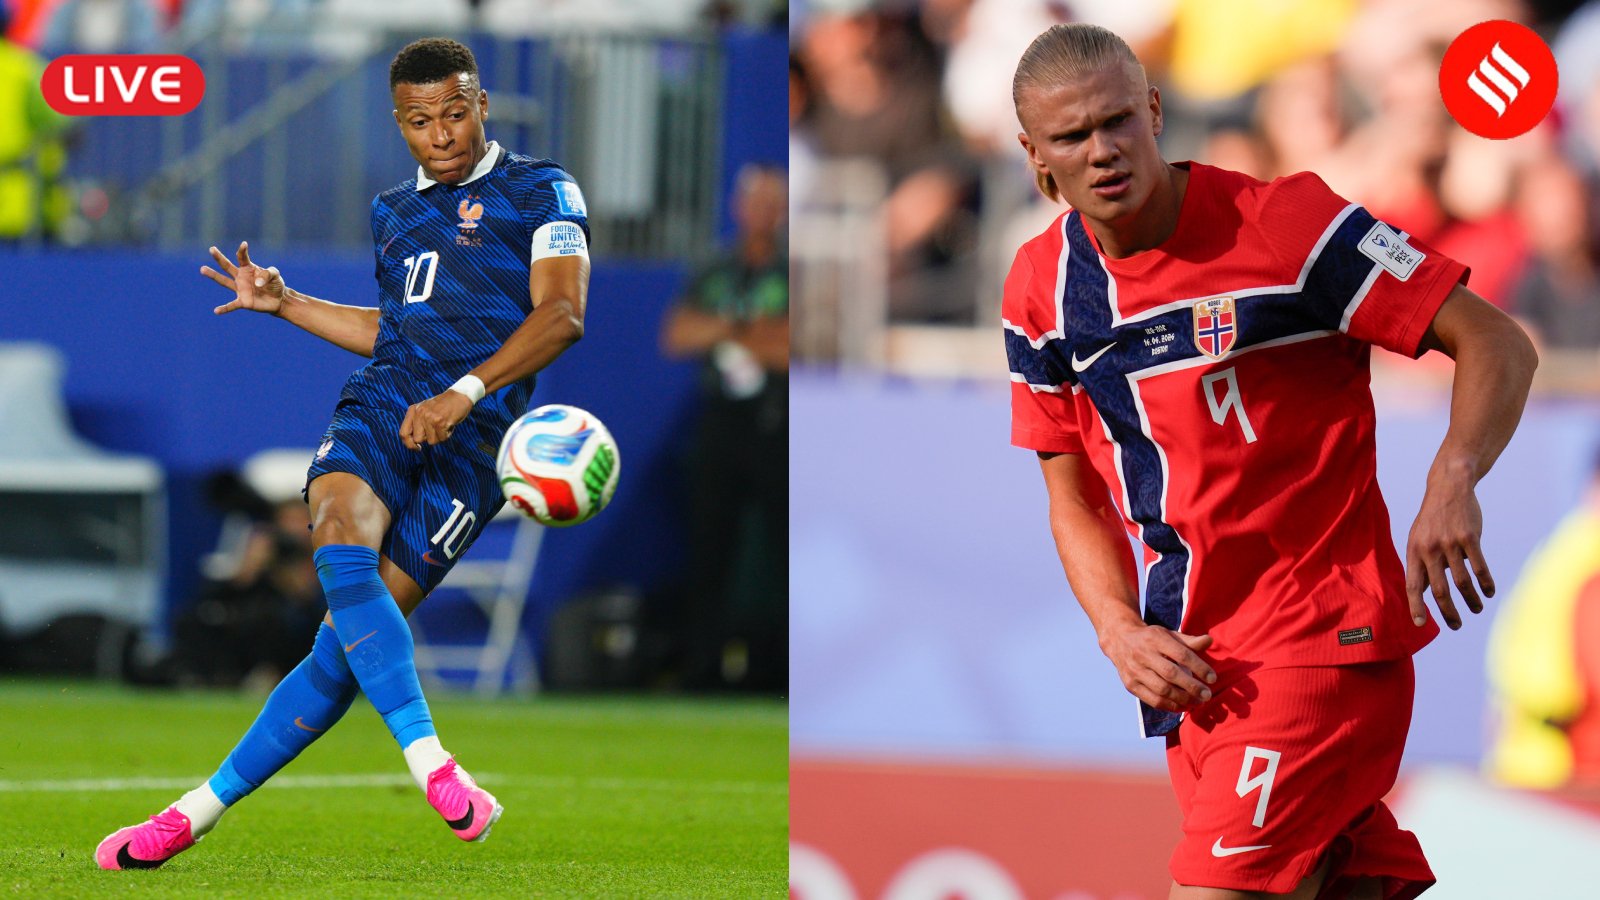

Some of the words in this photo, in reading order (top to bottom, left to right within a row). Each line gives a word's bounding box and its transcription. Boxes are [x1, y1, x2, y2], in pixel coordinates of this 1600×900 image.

[403, 251, 439, 307] 10
[1201, 366, 1258, 444] 9
[431, 498, 476, 559] 10
[1235, 746, 1282, 828] 9
